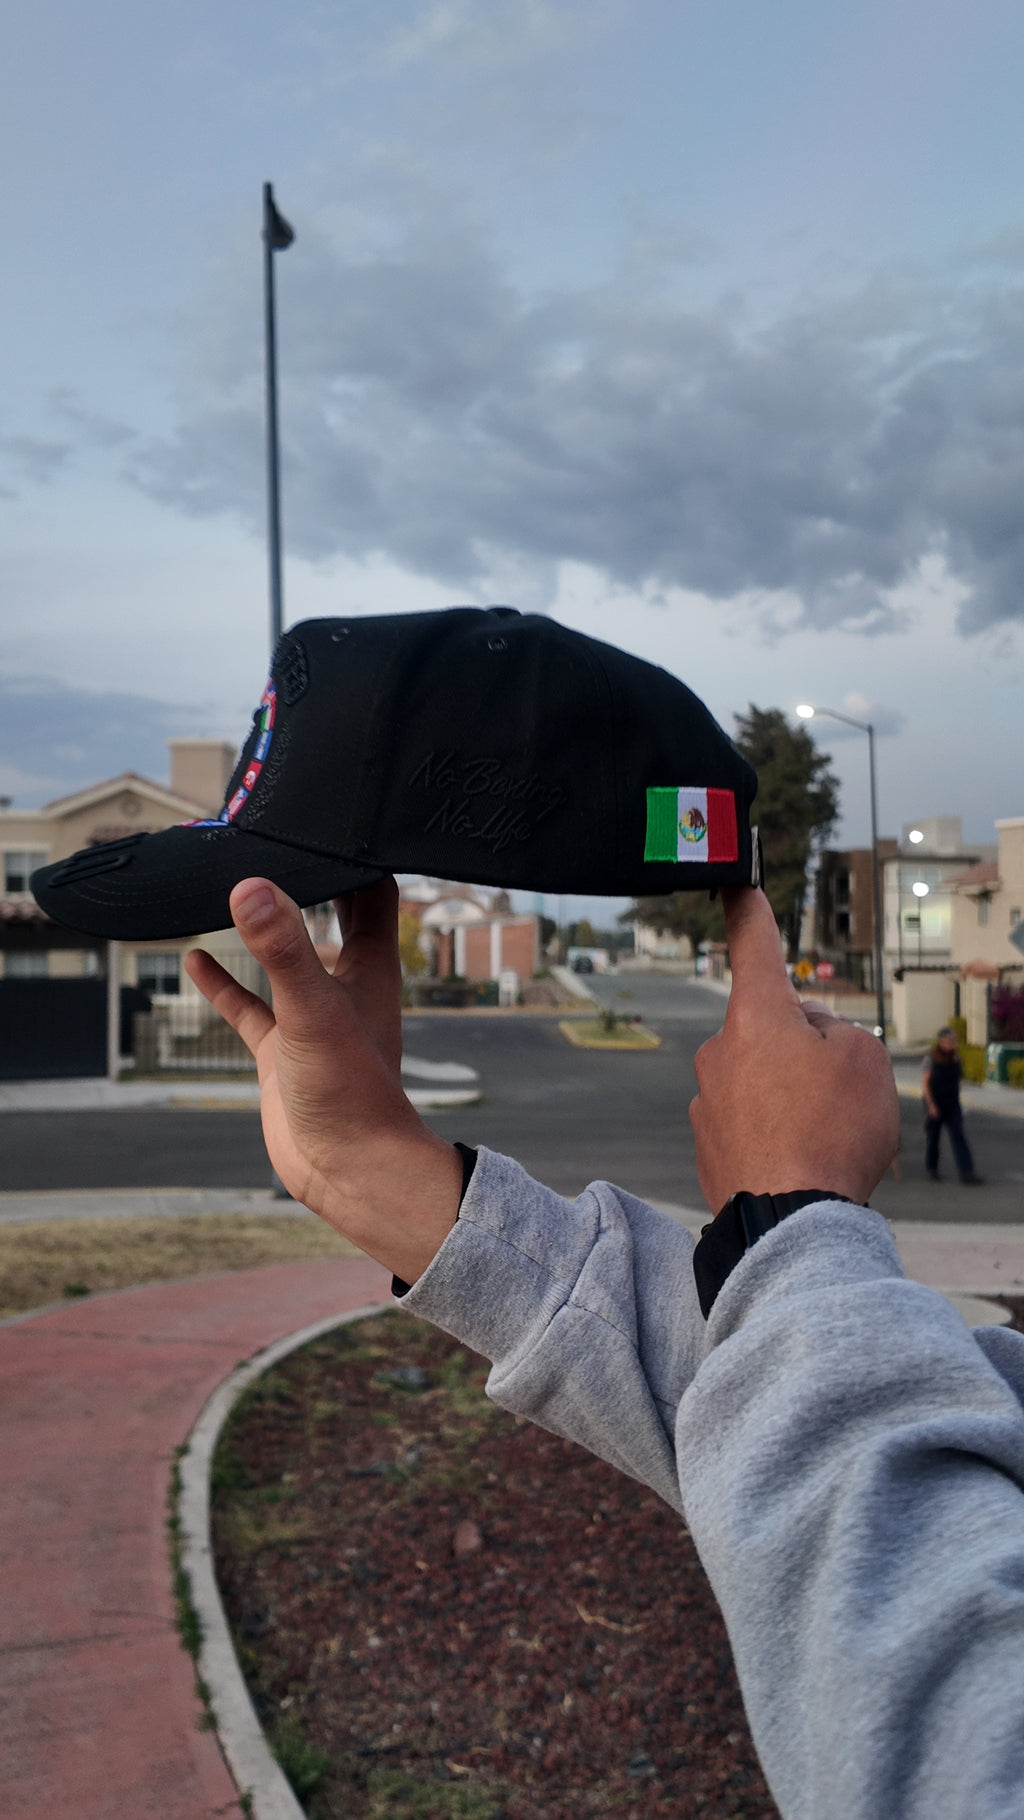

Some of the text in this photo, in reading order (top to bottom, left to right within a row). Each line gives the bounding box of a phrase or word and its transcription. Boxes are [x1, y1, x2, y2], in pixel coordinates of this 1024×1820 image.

[408, 752, 461, 788] No
[424, 798, 531, 854] No Life
